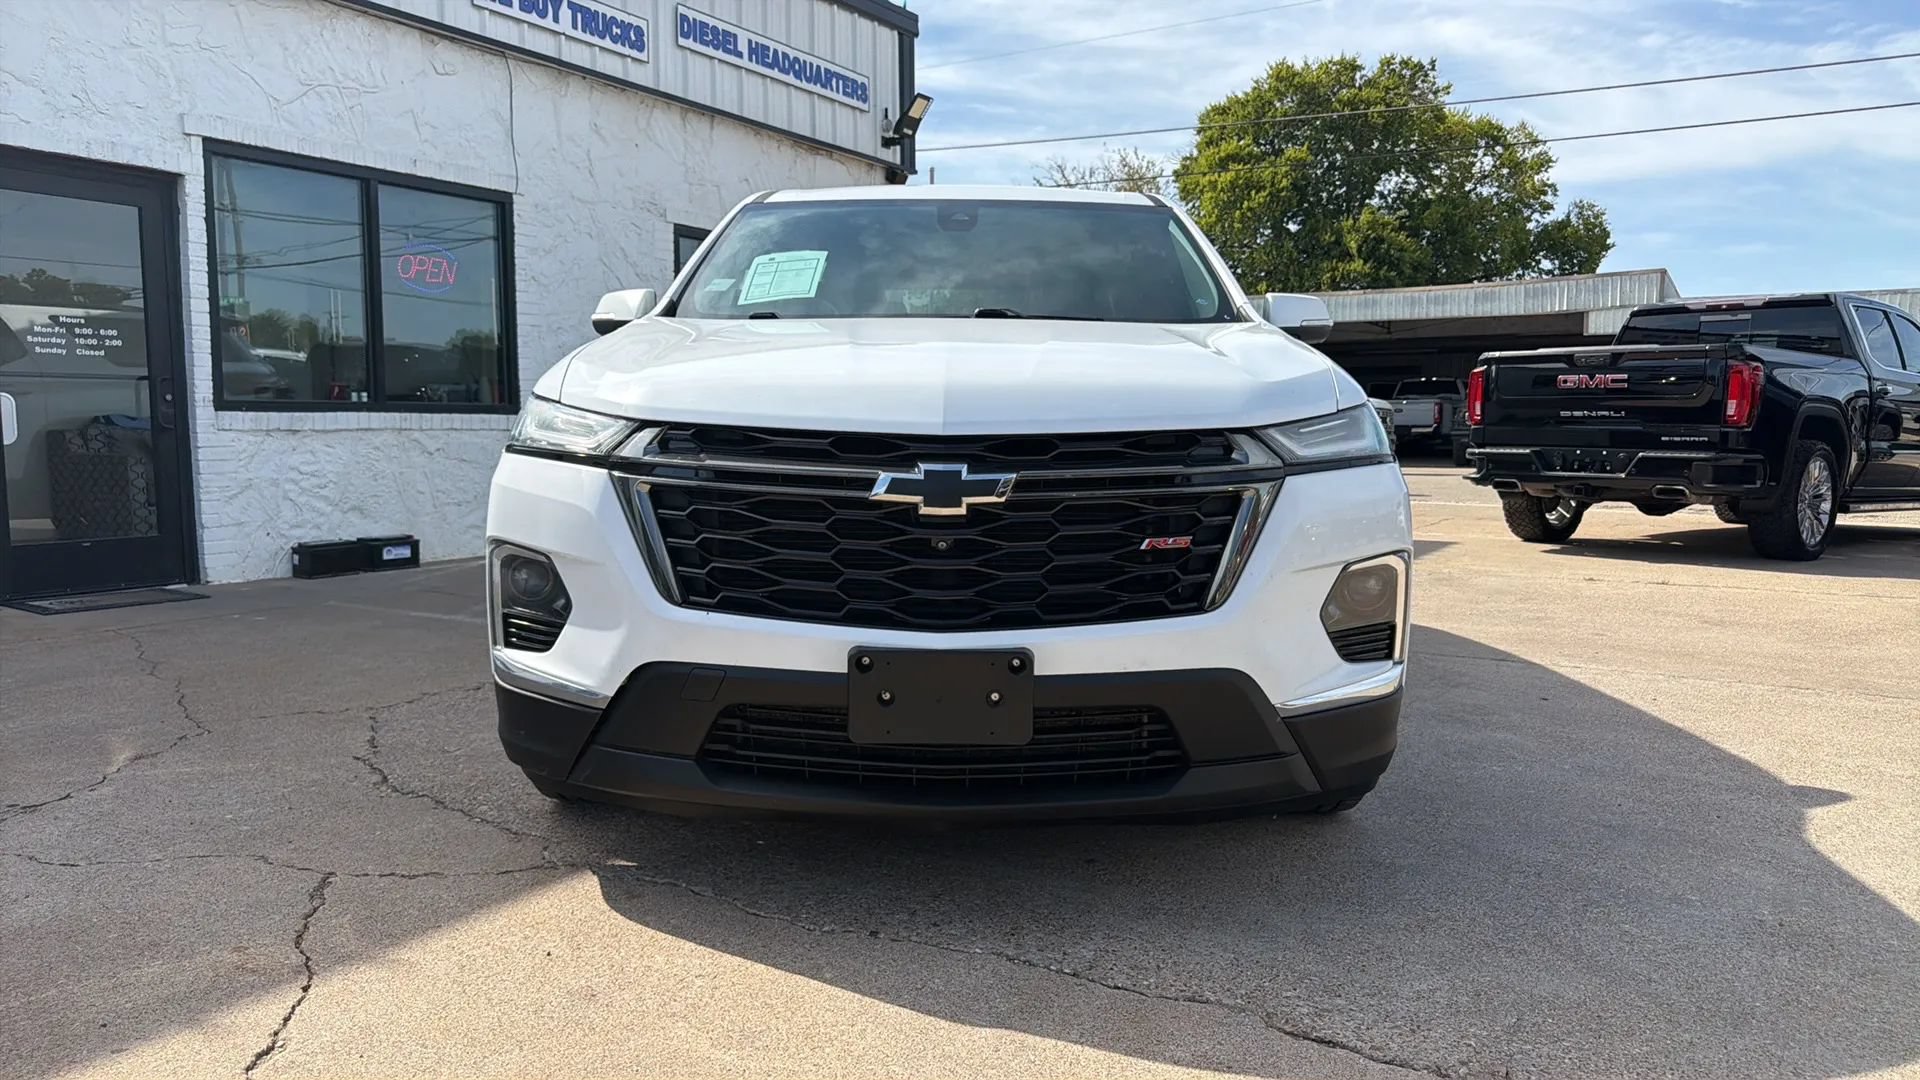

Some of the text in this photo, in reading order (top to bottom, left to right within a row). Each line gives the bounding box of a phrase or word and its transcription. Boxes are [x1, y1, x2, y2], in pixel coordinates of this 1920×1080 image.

[567, 0, 646, 54] TRUCKS
[679, 12, 868, 105] DIESEL HEADQUARTERS
[397, 254, 458, 285] OPEN
[59, 315, 85, 324] Hours
[33, 325, 66, 334] Mon-Fri
[74, 327, 93, 335] 9:00
[26, 335, 66, 345] Saturday
[34, 346, 105, 356] Sunday Closed
[1557, 374, 1628, 389] GMC
[1140, 536, 1193, 550] RS
